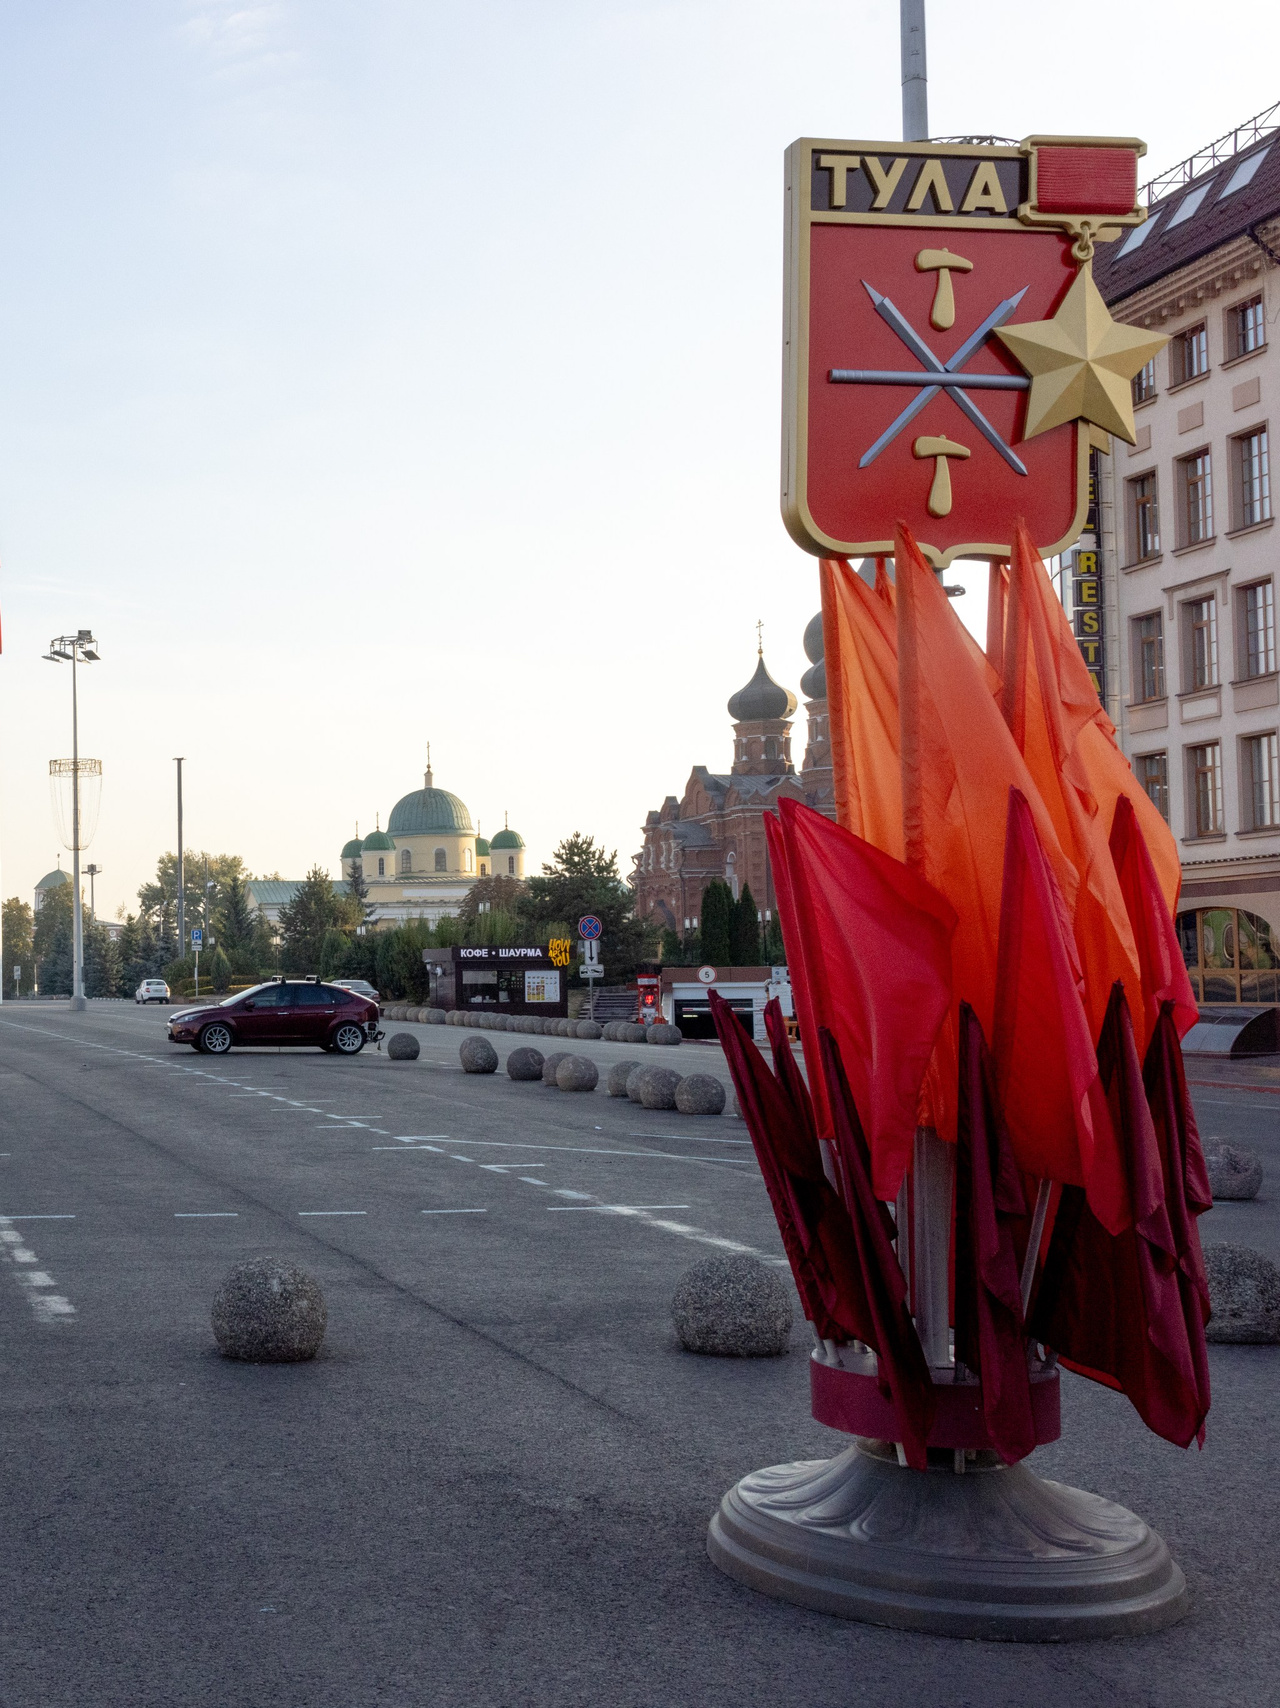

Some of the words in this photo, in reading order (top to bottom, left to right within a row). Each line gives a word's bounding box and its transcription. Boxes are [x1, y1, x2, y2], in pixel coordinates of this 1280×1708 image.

[816, 154, 1009, 214] ТУЛА
[549, 938, 570, 952] HOW
[460, 948, 489, 958] КОФЕ
[499, 948, 543, 958] ШАУРМА
[551, 951, 570, 967] YOU
[704, 971, 711, 979] 5
